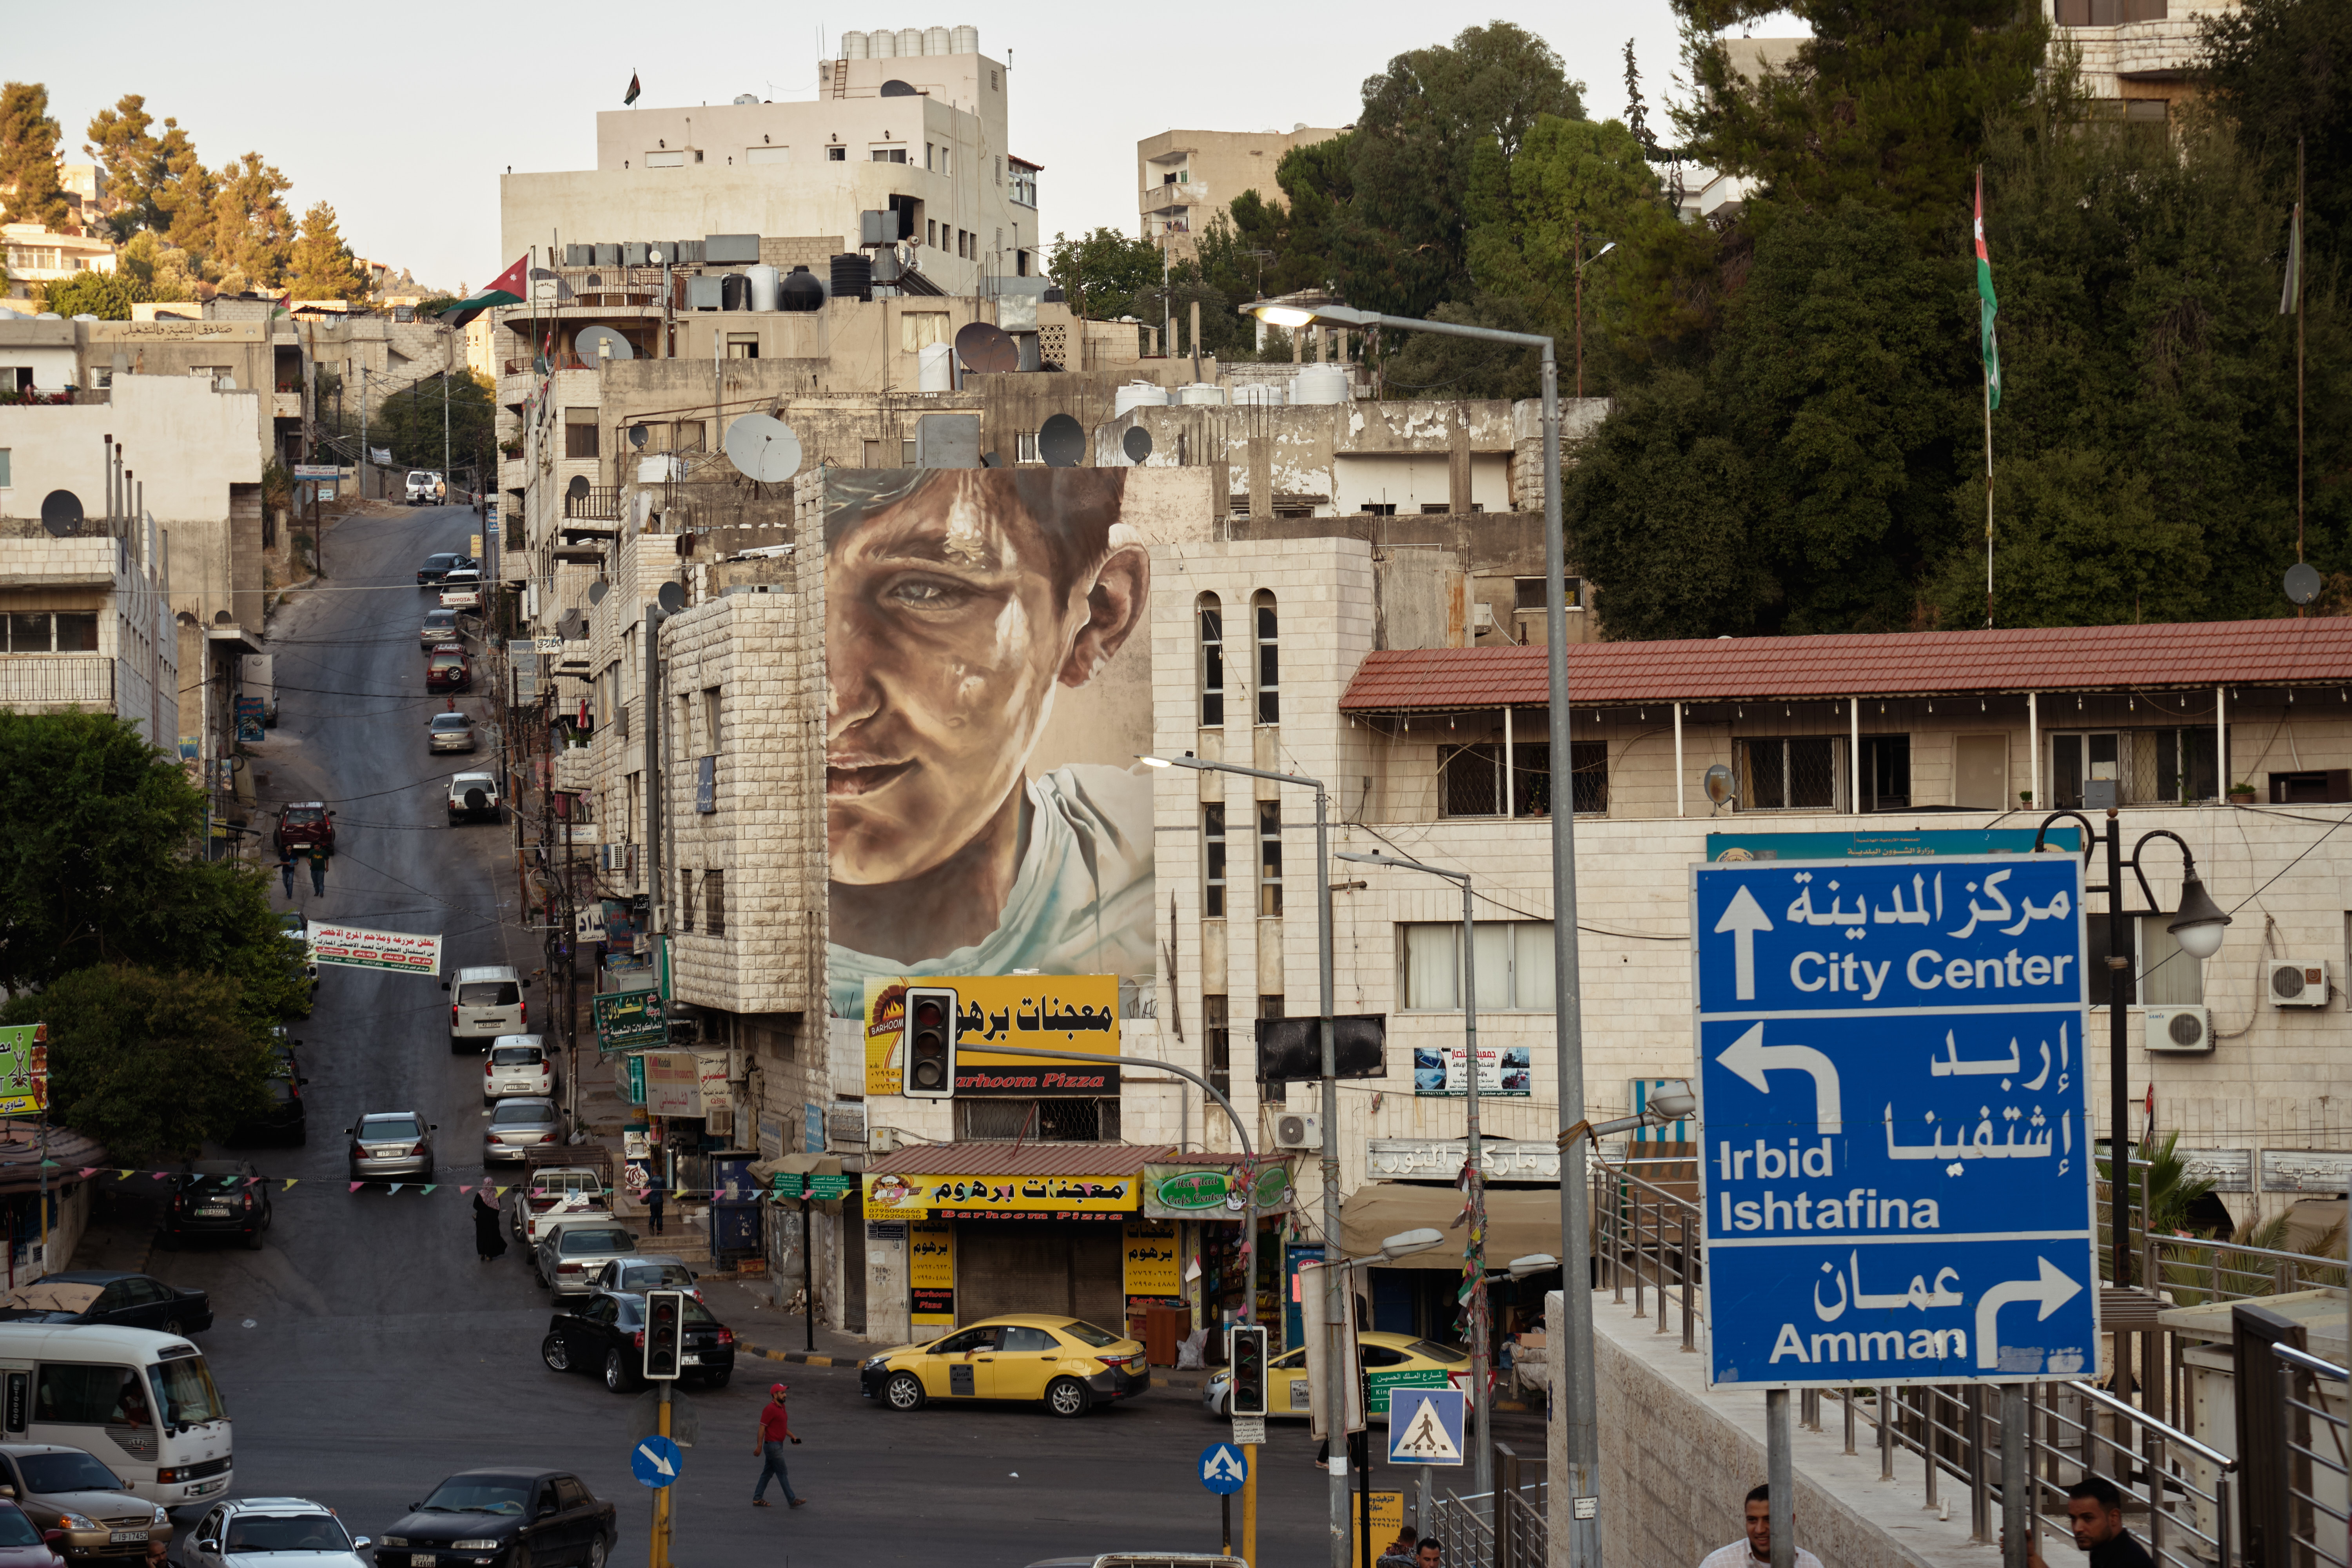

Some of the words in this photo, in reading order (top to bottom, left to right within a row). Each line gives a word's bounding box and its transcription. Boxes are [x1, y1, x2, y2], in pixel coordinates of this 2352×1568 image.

[122, 322, 164, 337] والتشغيل
[167, 322, 196, 337] التنمية
[198, 324, 233, 335] صندوق
[1917, 847, 1935, 855] وزارة
[1786, 870, 1942, 940] المدينة
[1947, 869, 2071, 940] مركز
[318, 927, 343, 937] الاخضر
[346, 931, 361, 940] المرج
[364, 933, 391, 944] وملاحم
[393, 935, 414, 946] مزرعة
[417, 938, 434, 947] تعلن
[1789, 950, 1891, 1001] City
[1906, 948, 2074, 990] Center
[608, 996, 644, 1020] الكروان
[1016, 994, 1114, 1041] معجنات
[871, 1018, 904, 1035] BARHOOM
[658, 1058, 671, 1068] Kodak
[1930, 1020, 2069, 1094] إربد
[674, 1070, 694, 1079] PRODUCTS
[955, 1073, 1037, 1087] arhoom
[1042, 1073, 1104, 1087] Pizza
[1884, 1101, 2071, 1178] إشتفينا
[1381, 1143, 1448, 1174] النور
[1720, 1137, 1833, 1180] Irbid
[2276, 1160, 2343, 1179] التجارية
[1174, 1175, 1218, 1189] Hadad
[1261, 1171, 1281, 1187] Haddad
[935, 1179, 1015, 1204] برهوم
[1021, 1178, 1125, 1202] معجنات
[1258, 1192, 1269, 1204] Cafe
[1269, 1187, 1284, 1200] Center
[1167, 1193, 1191, 1206] Cafe
[1193, 1191, 1225, 1203] Center
[941, 1210, 1049, 1220] Barhoom
[1056, 1211, 1123, 1221] Pizza
[1720, 1189, 1941, 1232] Ishtafina
[913, 1220, 949, 1236] معجنات
[1127, 1223, 1175, 1242] معجنات
[913, 1241, 948, 1256] برهوم
[1128, 1247, 1173, 1263] برهوم
[1814, 1249, 1964, 1322] عمان
[1769, 1323, 1968, 1365] Amman
[1377, 1373, 1401, 1382] الحسين
[1423, 1371, 1442, 1381] شارع
[118, 1532, 147, 1541] 19-17452
